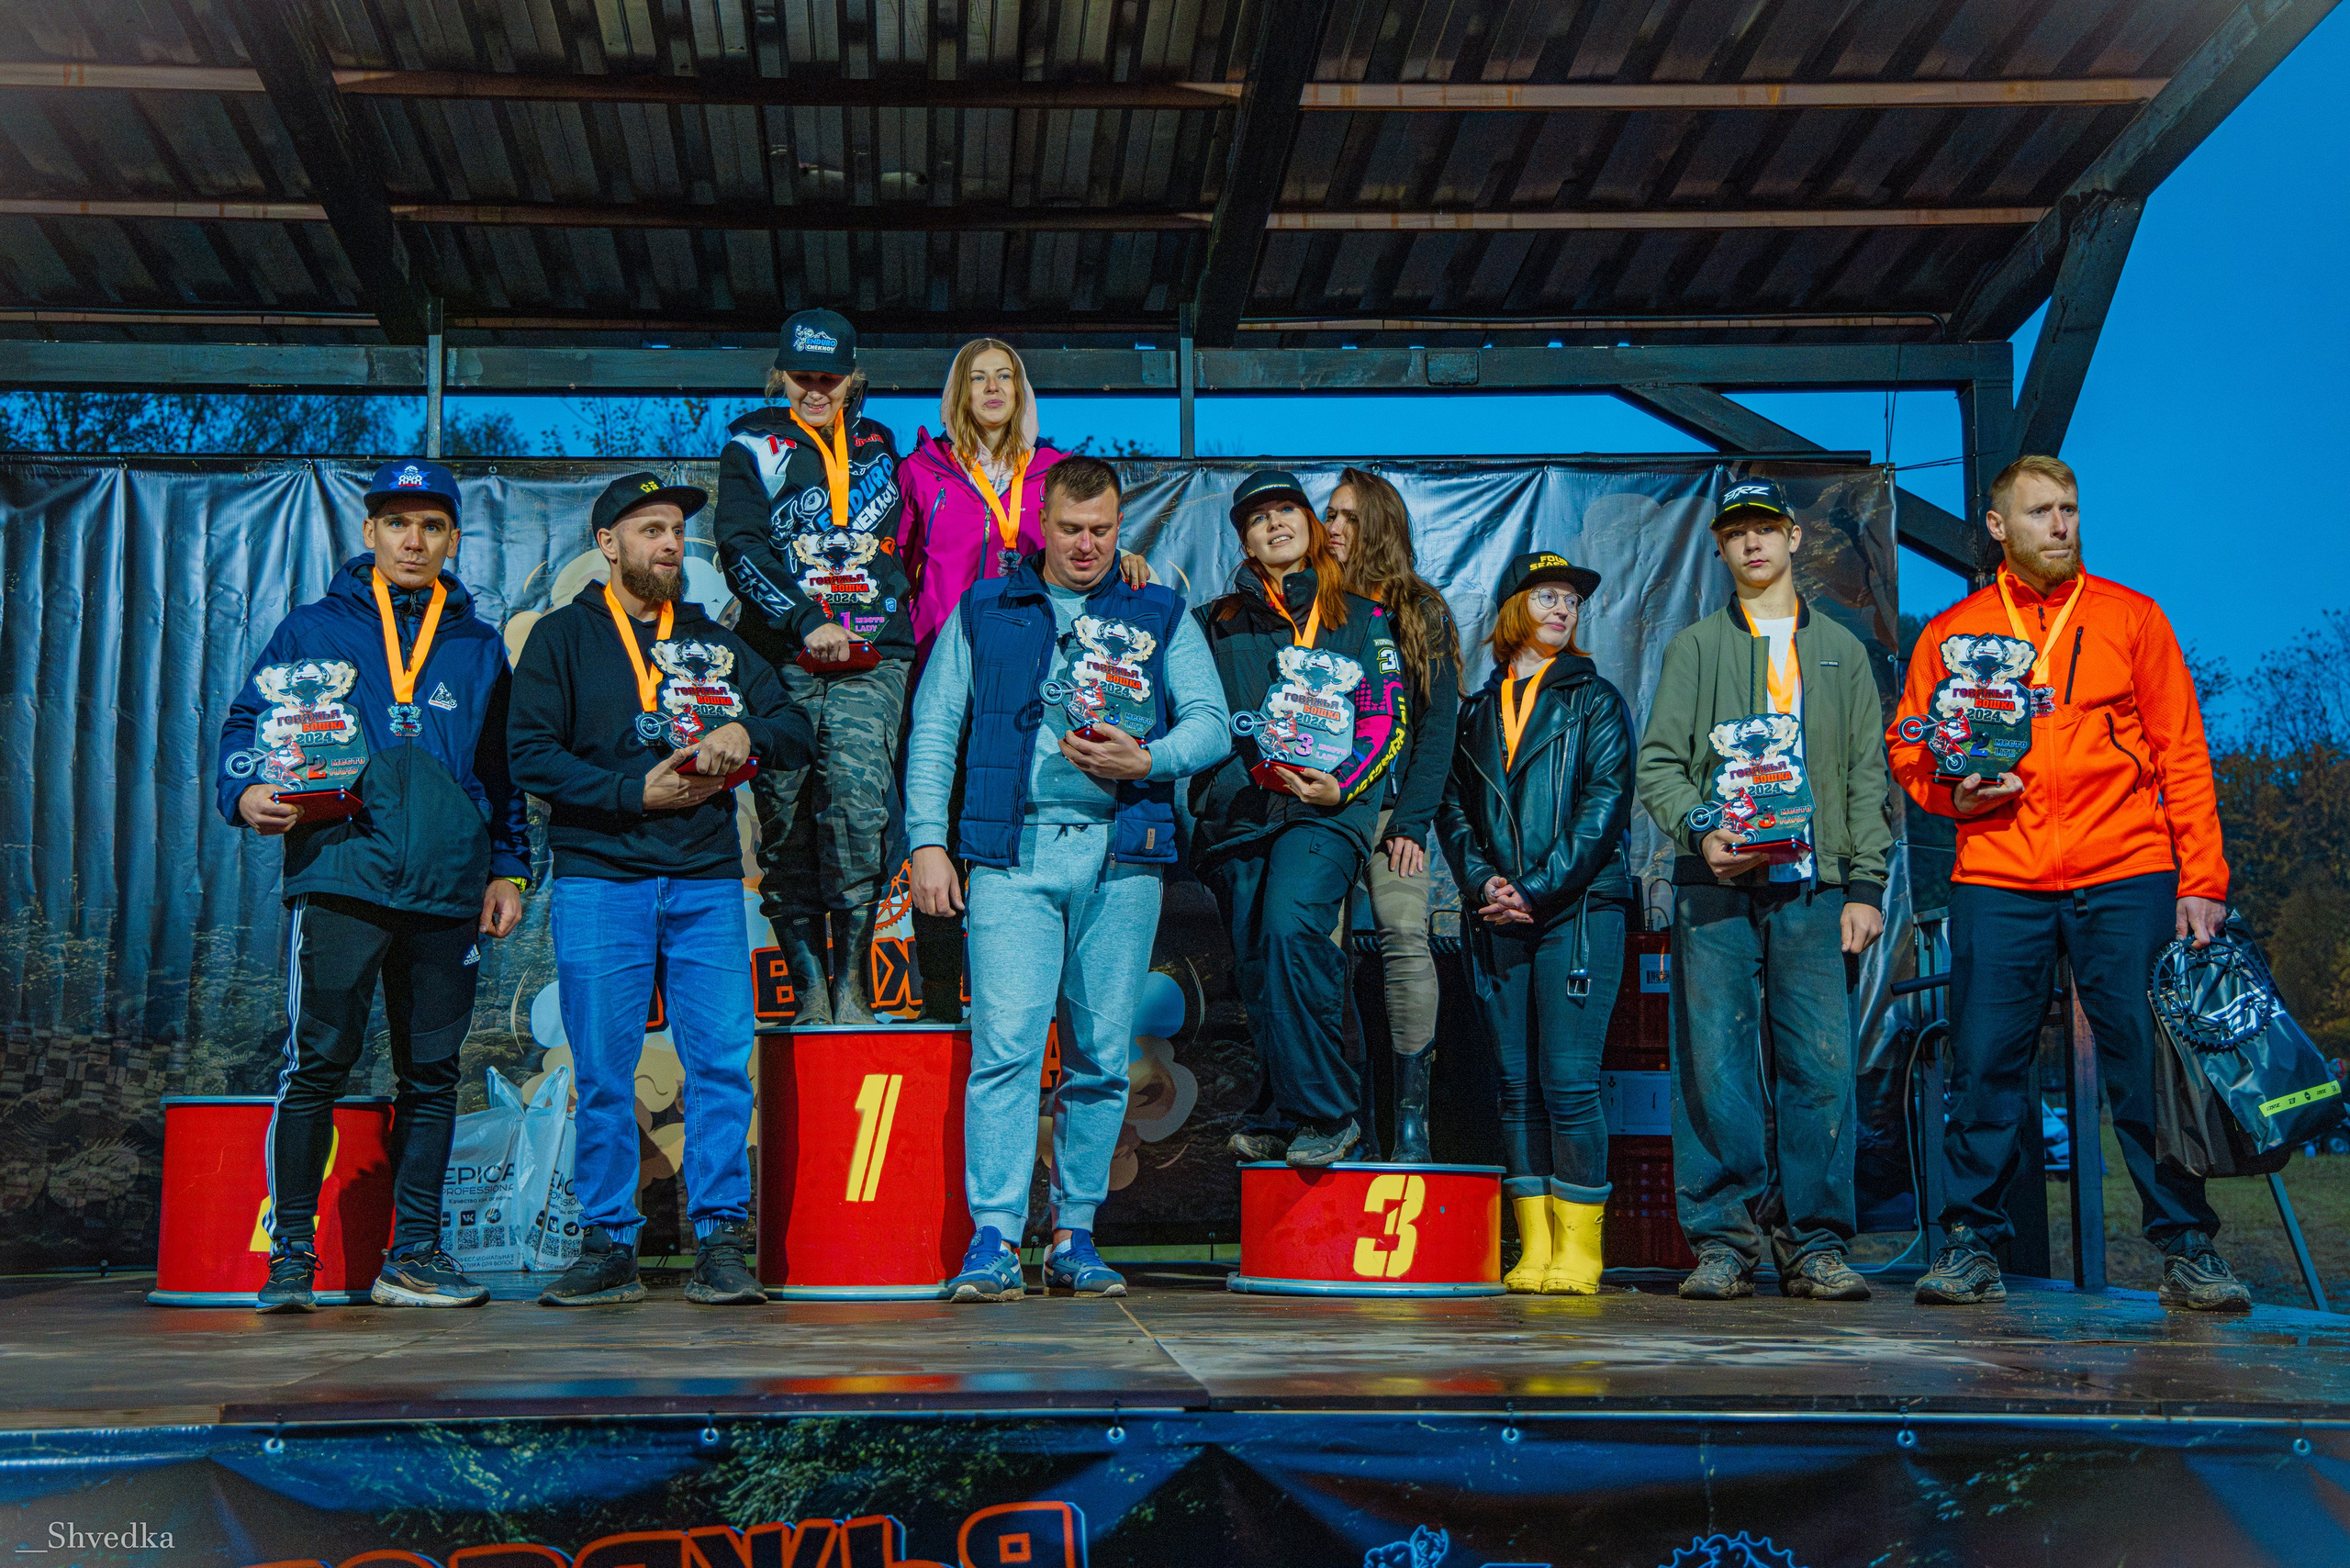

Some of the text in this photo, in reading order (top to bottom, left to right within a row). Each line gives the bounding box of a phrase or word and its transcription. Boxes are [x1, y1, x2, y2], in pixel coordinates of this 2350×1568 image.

[806, 338, 836, 347] ENDURO
[817, 457, 893, 532] EDURO
[809, 574, 865, 586] ГОВЯЖЬЯ
[831, 584, 869, 593] БОШКА
[826, 593, 858, 603] 2024
[855, 624, 878, 633] LADY
[1087, 661, 1139, 679] ГОВЯЖЬЯ
[1105, 673, 1143, 690] БОШКА
[674, 686, 728, 696] ГОВЯЖЬЯ
[1100, 681, 1131, 698] 2024
[1953, 688, 2012, 699] ГОВЯЖЬЯ
[696, 695, 734, 706] БОШКА
[1284, 692, 1339, 710] ГОВЯЖЬЯ
[1974, 699, 2016, 711] БОШКА
[692, 704, 724, 715] 2024
[1304, 704, 1341, 721] БОШКА
[1966, 708, 2001, 722] 2024
[276, 709, 341, 727] ГОВЯЖЬЯ
[1295, 712, 1327, 729] 2024
[302, 720, 347, 733] БОШКА
[296, 732, 333, 744] 2024
[1294, 734, 1314, 756] 3
[1970, 732, 1990, 757] 2
[308, 755, 327, 778] 2
[330, 767, 358, 776] HARD
[1729, 760, 1787, 780] ГОВЯЖЬЯ
[1752, 770, 1793, 785] БОШКА
[1747, 783, 1782, 797] 2024
[1757, 804, 1776, 828] 3
[1780, 815, 1806, 824] HARD
[845, 1074, 903, 1202] 1
[1353, 1174, 1426, 1277] 3
